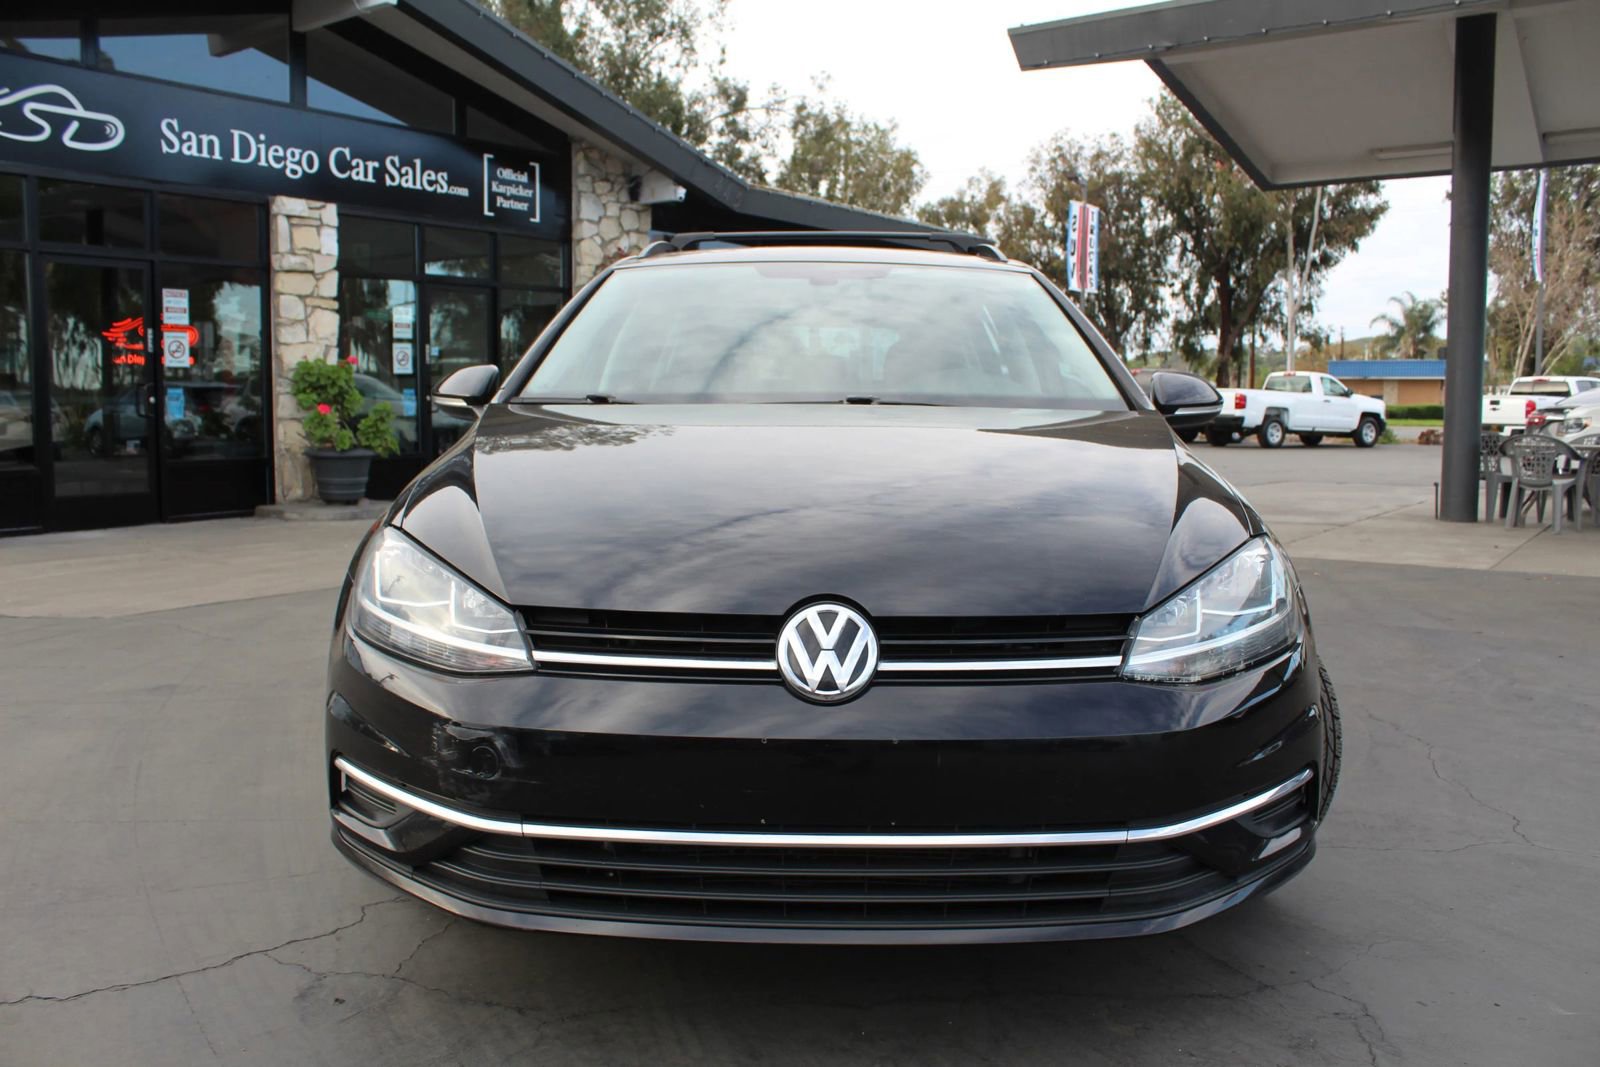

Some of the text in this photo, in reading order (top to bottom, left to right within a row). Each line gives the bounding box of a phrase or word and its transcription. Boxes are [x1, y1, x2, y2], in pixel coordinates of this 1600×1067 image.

[160, 118, 222, 161] San
[230, 128, 320, 179] Diego
[328, 146, 379, 184] Car
[496, 167, 529, 183] Official
[491, 181, 534, 198] Karpicker
[496, 195, 529, 211] Partner
[780, 606, 875, 694] VW
